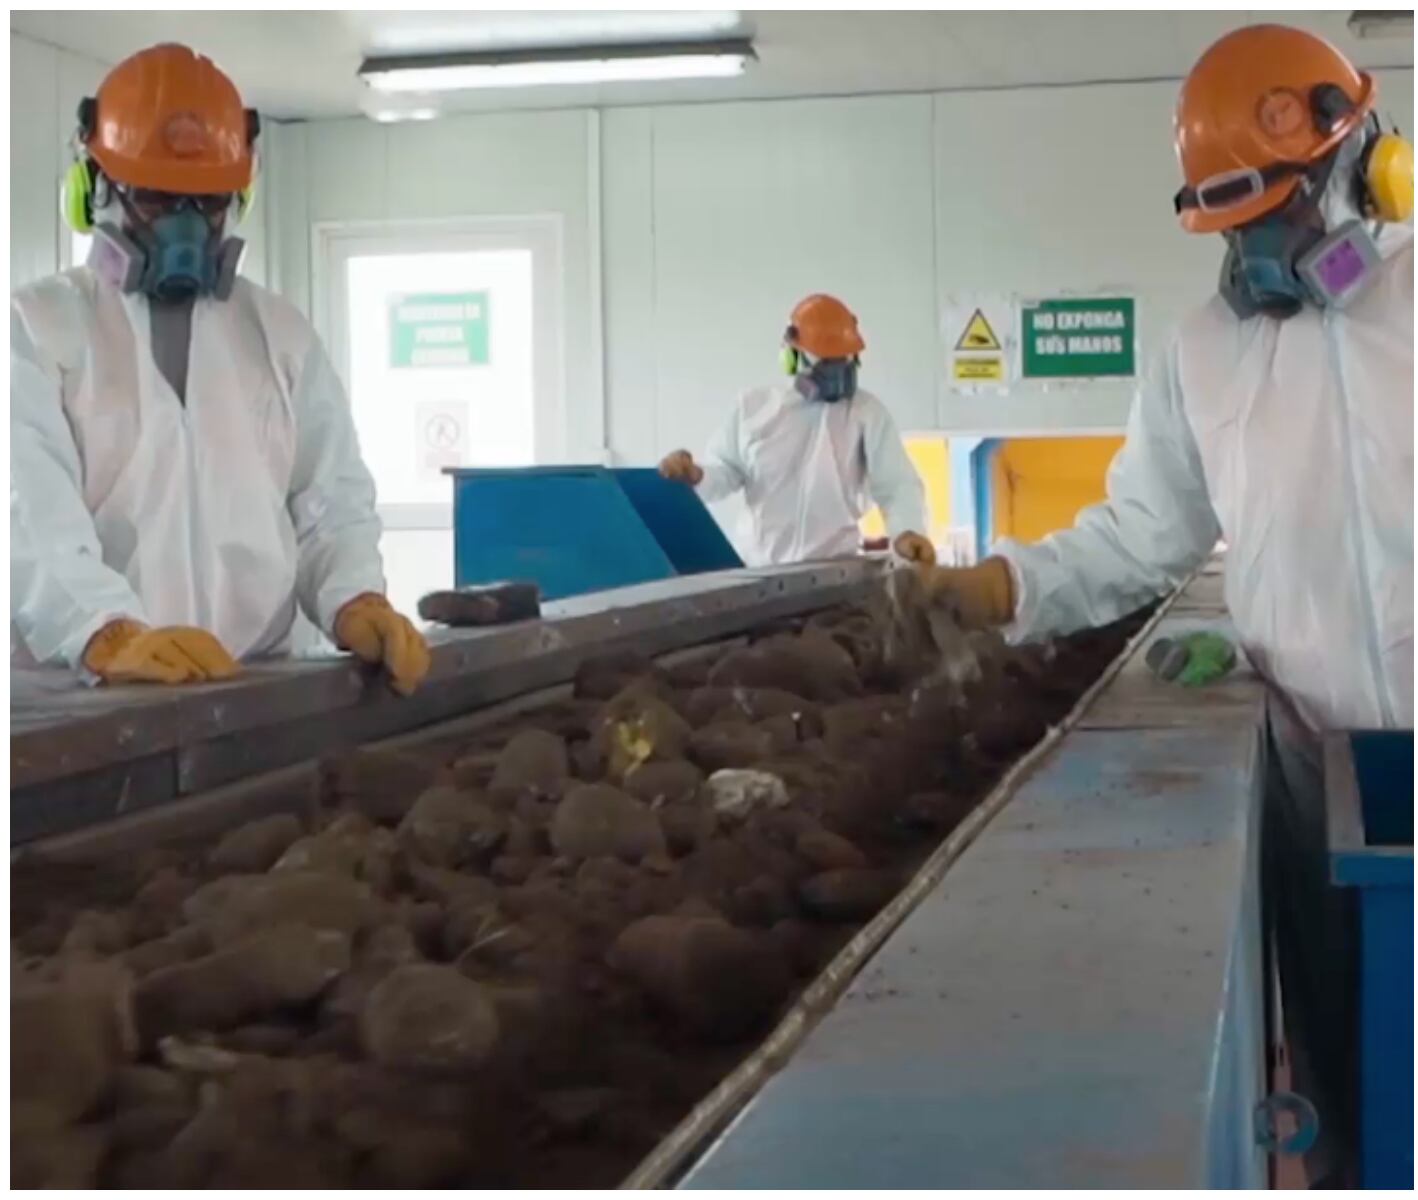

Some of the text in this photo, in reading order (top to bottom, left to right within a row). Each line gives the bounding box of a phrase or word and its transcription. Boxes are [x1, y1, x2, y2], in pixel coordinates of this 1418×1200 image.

[1033, 310, 1125, 330] NO EXPONGA
[1068, 335, 1123, 354] MANOS
